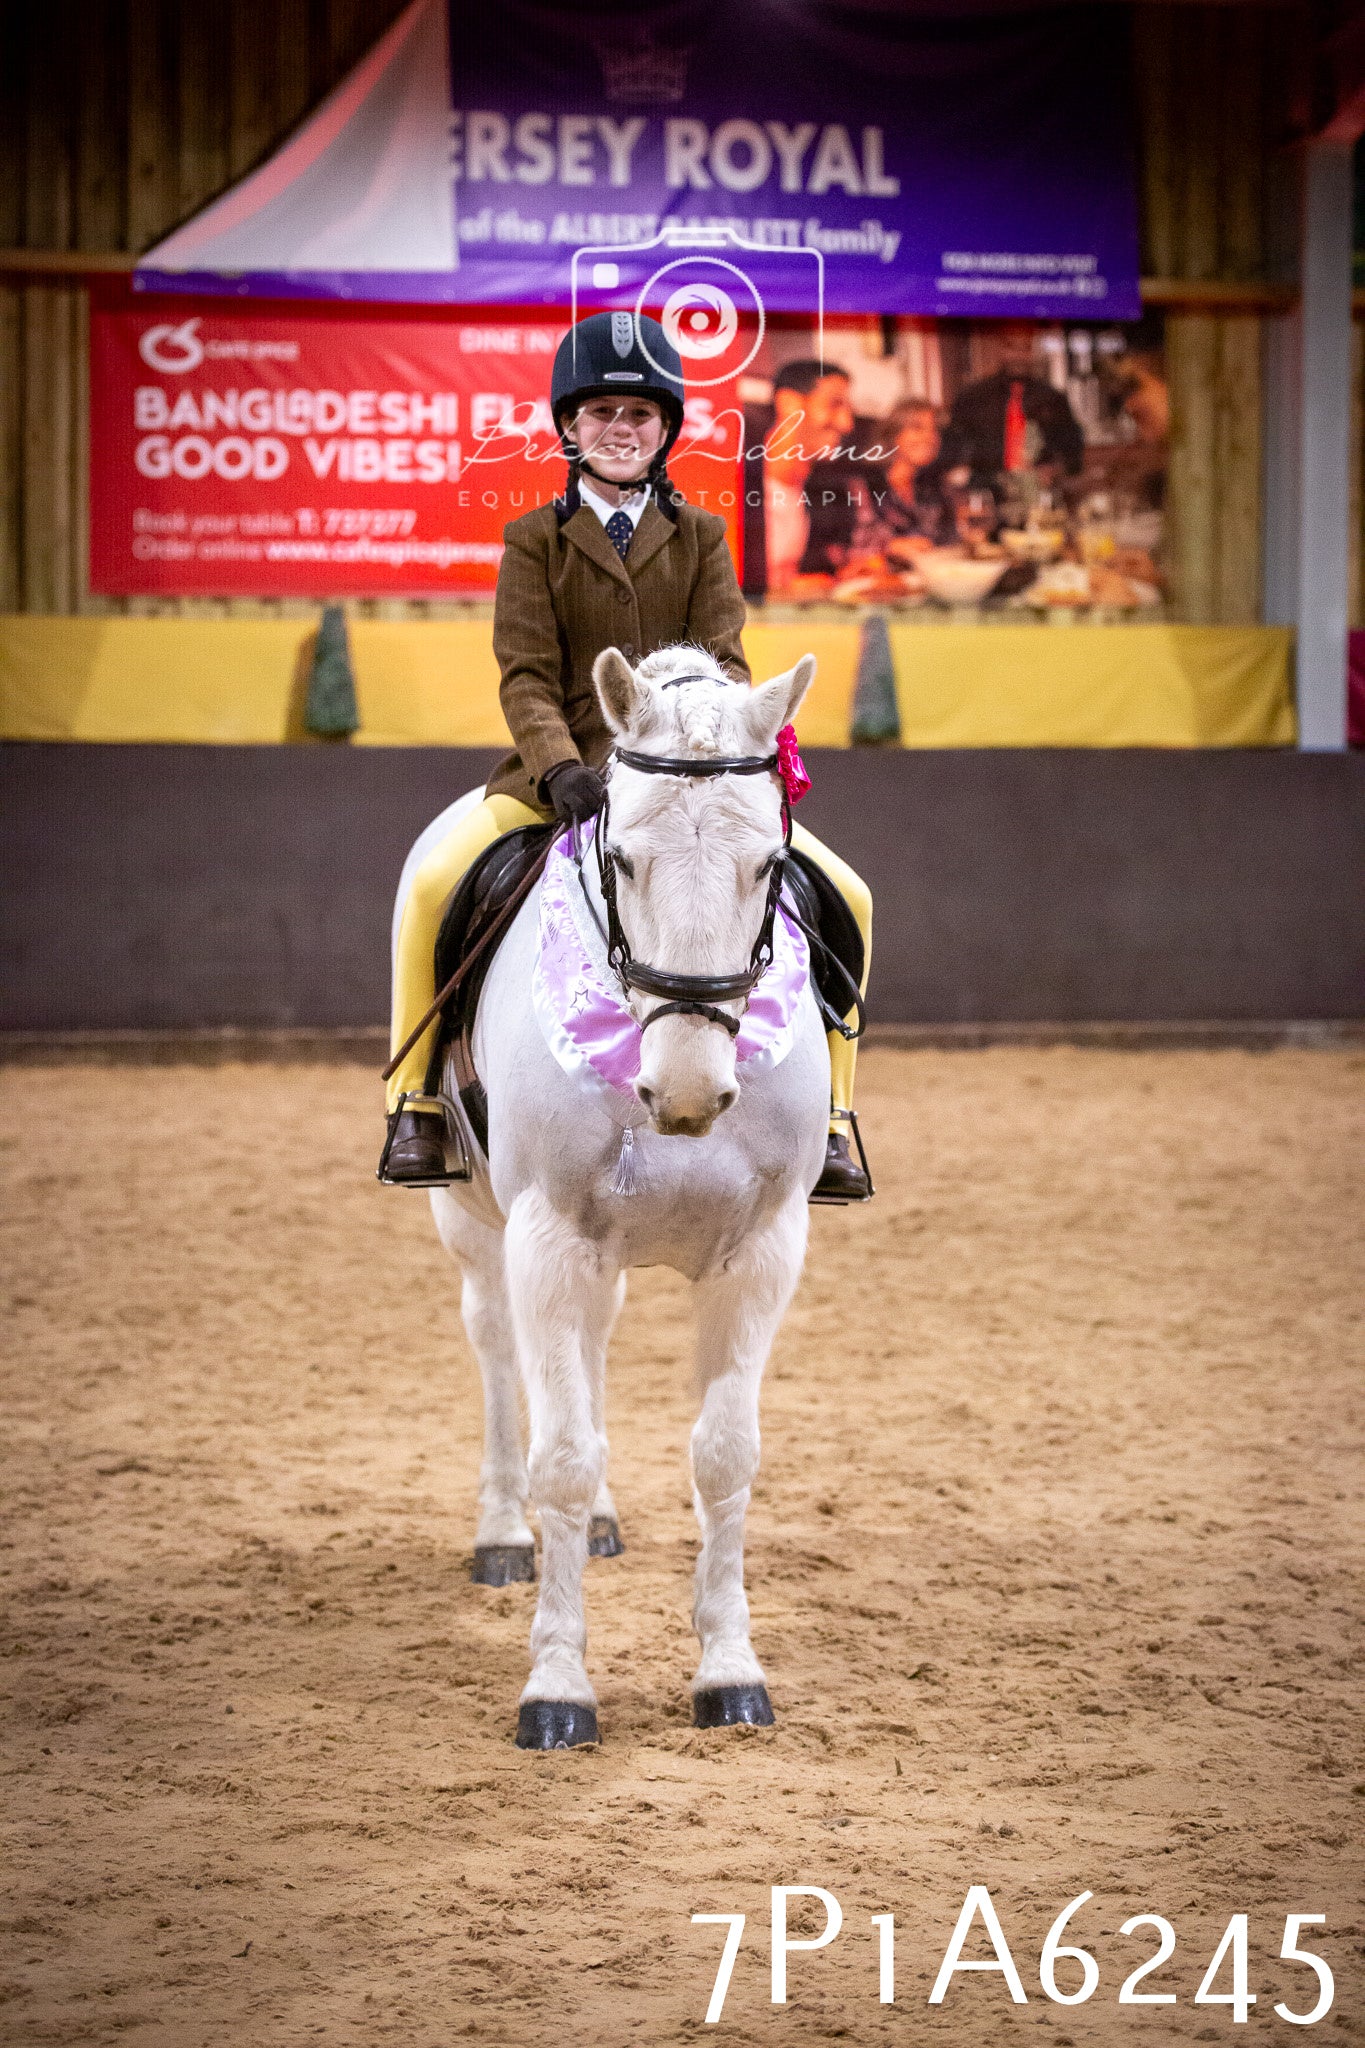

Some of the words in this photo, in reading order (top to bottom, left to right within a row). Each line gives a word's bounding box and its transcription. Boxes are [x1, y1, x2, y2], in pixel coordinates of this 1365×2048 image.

[664, 120, 899, 196] ROYAL
[458, 208, 493, 243] of
[497, 208, 547, 245] the
[551, 212, 658, 247] ALBERT
[804, 217, 900, 263] family
[459, 327, 519, 354] DINE
[524, 328, 555, 354] IN
[135, 387, 458, 435] BANGLADESHI
[135, 436, 290, 480] GOOD
[303, 438, 461, 483] VIBES!
